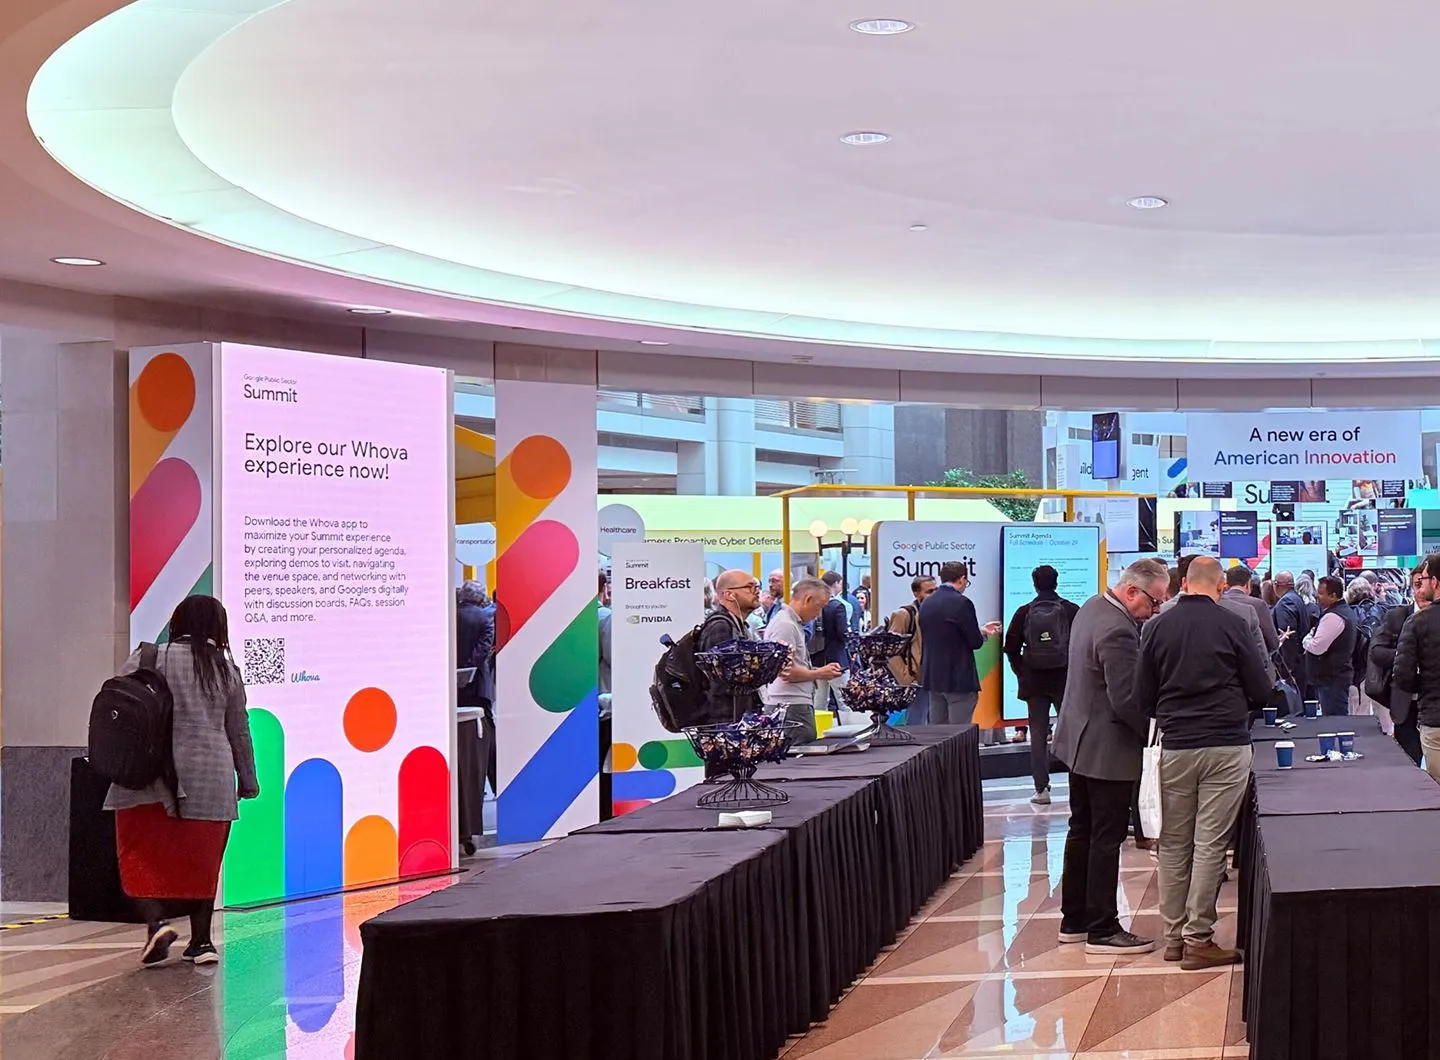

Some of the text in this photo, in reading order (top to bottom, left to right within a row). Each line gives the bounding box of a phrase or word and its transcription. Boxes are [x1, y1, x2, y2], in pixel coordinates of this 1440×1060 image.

[244, 383, 298, 402] Summit
[1249, 426, 1361, 442] A new era of
[245, 433, 408, 460] Explore our Whova
[1214, 449, 1396, 466] American Innovation
[244, 458, 389, 480] experience now!
[244, 515, 368, 531] Download the Whova app to
[600, 526, 637, 534] Healthcare
[1031, 532, 1052, 540] Agenda
[244, 531, 391, 543] maximize your Summit experience
[720, 536, 746, 547] Cyber
[244, 543, 407, 558] by creating your personalized agenda,
[892, 541, 976, 552] Google Public Sector
[244, 557, 287, 570] exploring
[288, 557, 320, 568] demos
[321, 559, 331, 568] to
[352, 558, 396, 570] navigating
[892, 555, 977, 577] Sumit
[244, 571, 260, 581] the
[262, 573, 290, 581] venue
[322, 571, 339, 581] and
[340, 571, 388, 583] networking
[388, 572, 407, 581] with
[625, 577, 691, 590] Breakfast
[244, 584, 409, 598] peers, speakers, and Googlers digitally
[244, 599, 264, 609] with
[266, 598, 314, 609] discussion
[315, 598, 347, 608] boards,
[375, 597, 405, 607] session
[244, 612, 316, 623] Q&A, and more.
